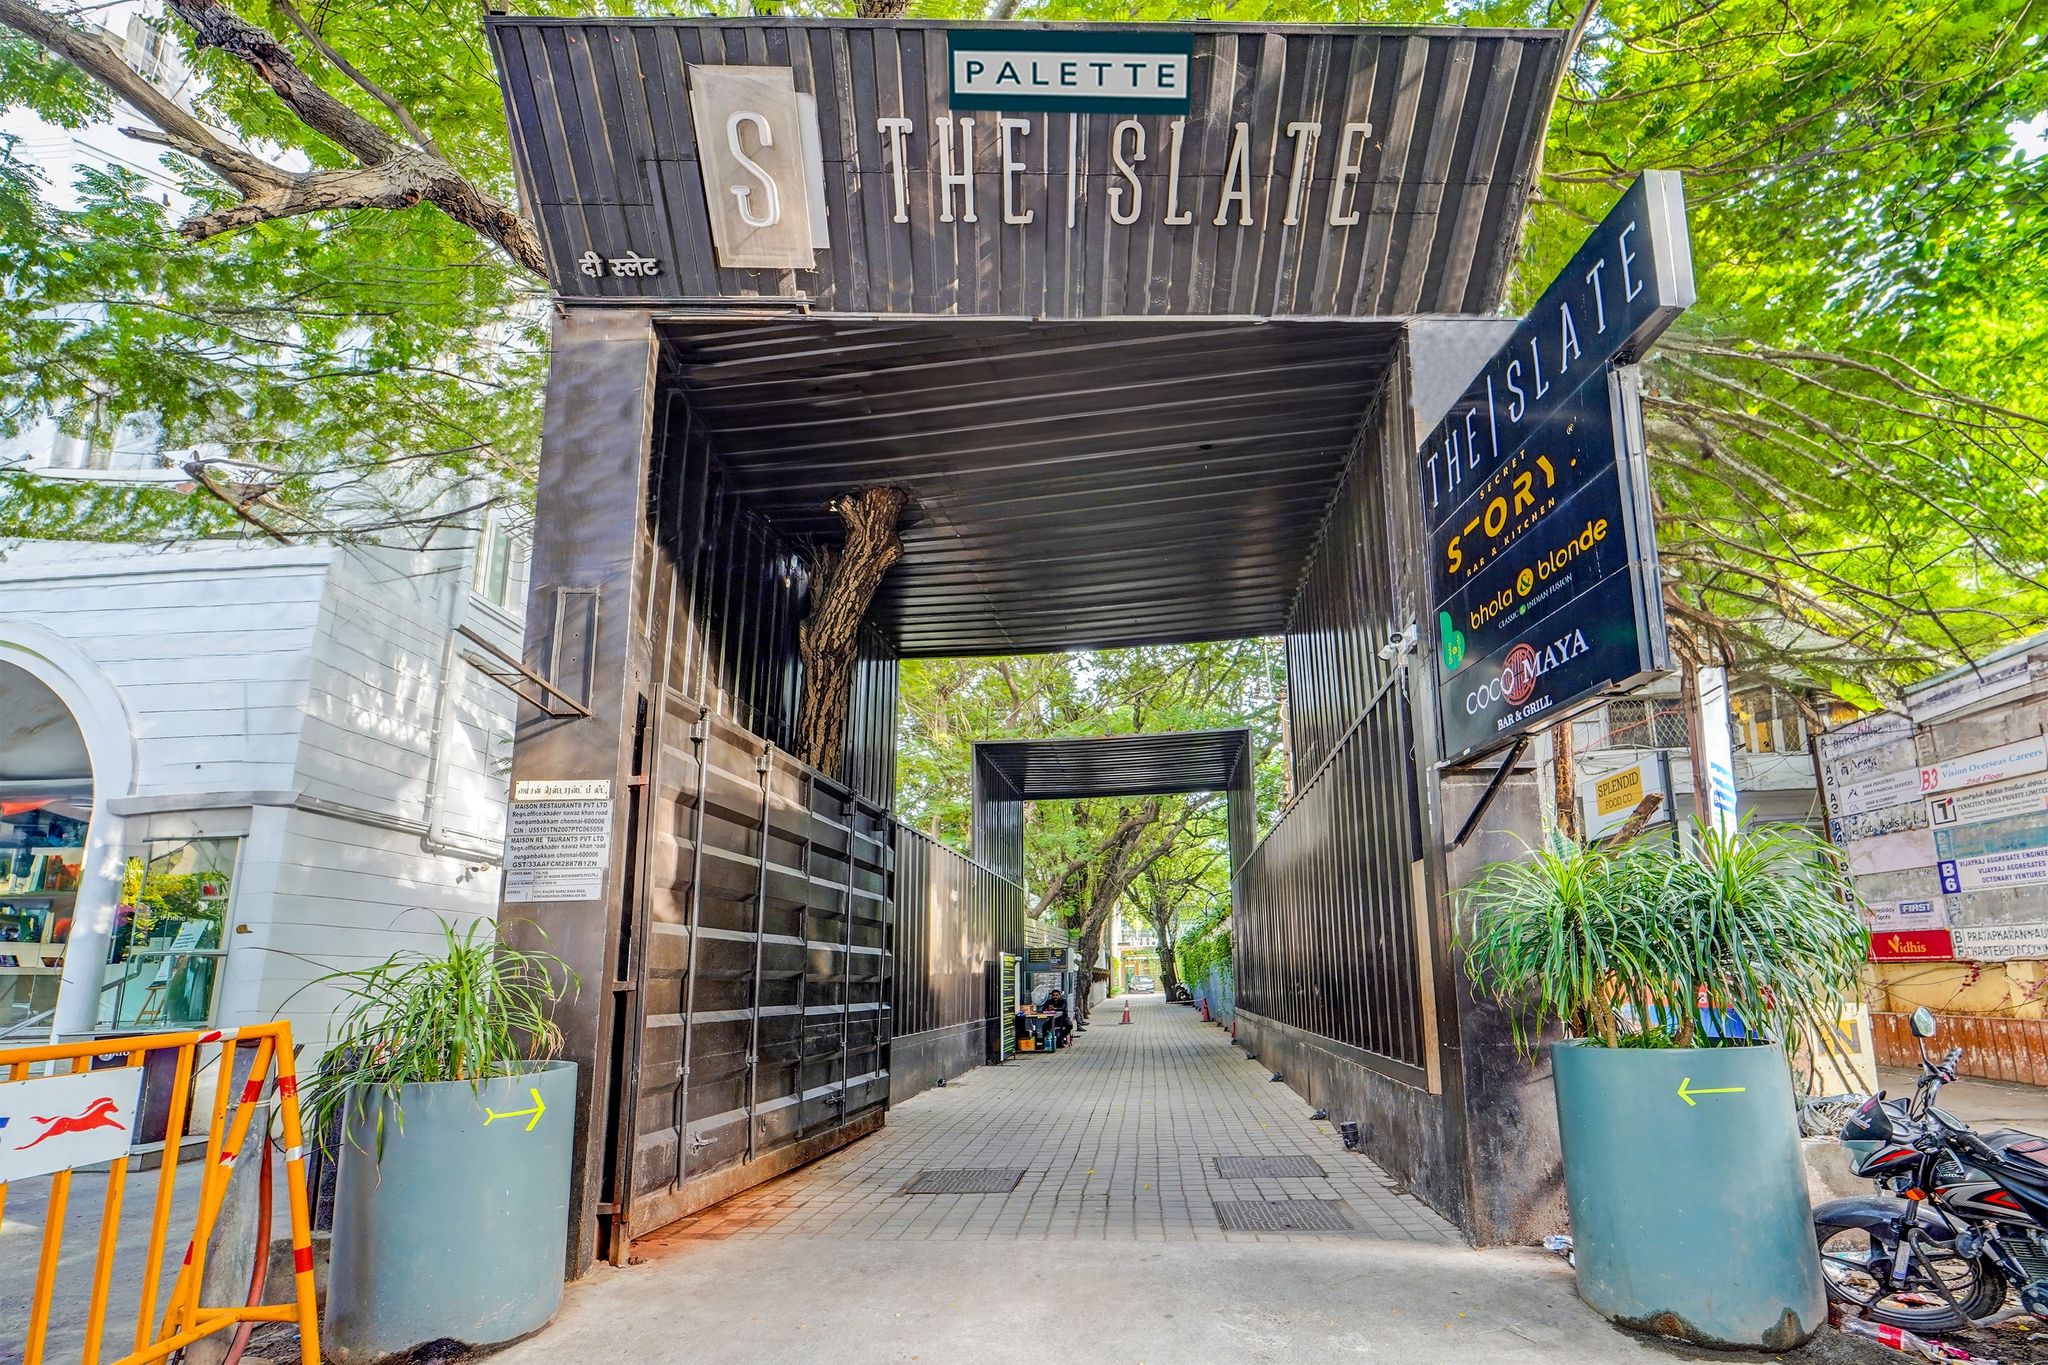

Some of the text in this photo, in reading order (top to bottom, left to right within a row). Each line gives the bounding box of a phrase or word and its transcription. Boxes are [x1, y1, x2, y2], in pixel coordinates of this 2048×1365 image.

[966, 60, 1177, 89] PALETTE
[727, 110, 782, 228] S
[877, 116, 1373, 228] THE SLATE
[578, 250, 659, 278] दी स्लेट
[1427, 221, 1643, 509] THE SLATE
[1479, 449, 1526, 500] SECRET
[1466, 559, 1485, 577] BAR
[1503, 497, 1555, 546] KITCHEN
[1469, 588, 1514, 631] bhola
[1538, 517, 1608, 581] blonde
[1526, 589, 1549, 610] INDIAN
[1466, 667, 1514, 716] COCO
[1521, 628, 1589, 682] MAYA
[1497, 695, 1553, 732] BAR & GRILL
[1941, 749, 2043, 779] Vision Overseas Careers
[1597, 771, 1639, 798] SPLENDID
[1920, 767, 1939, 792] B3
[1966, 771, 2005, 786] 2nd Floor
[1605, 796, 1622, 809] FOOD
[1986, 795, 2002, 806] INDIA
[2002, 791, 2025, 803] PRIVATE
[511, 836, 534, 844] MAISON
[1958, 857, 1986, 868] VIJAYRAJ
[1986, 853, 2021, 865] AGGREGATE
[1978, 861, 2046, 875] VIJAYRAJ AGGREGATES
[1981, 870, 2047, 884] OCTONARY VENTURES
[1901, 902, 1931, 914] FIRST
[1887, 934, 1927, 954] Vidhis
